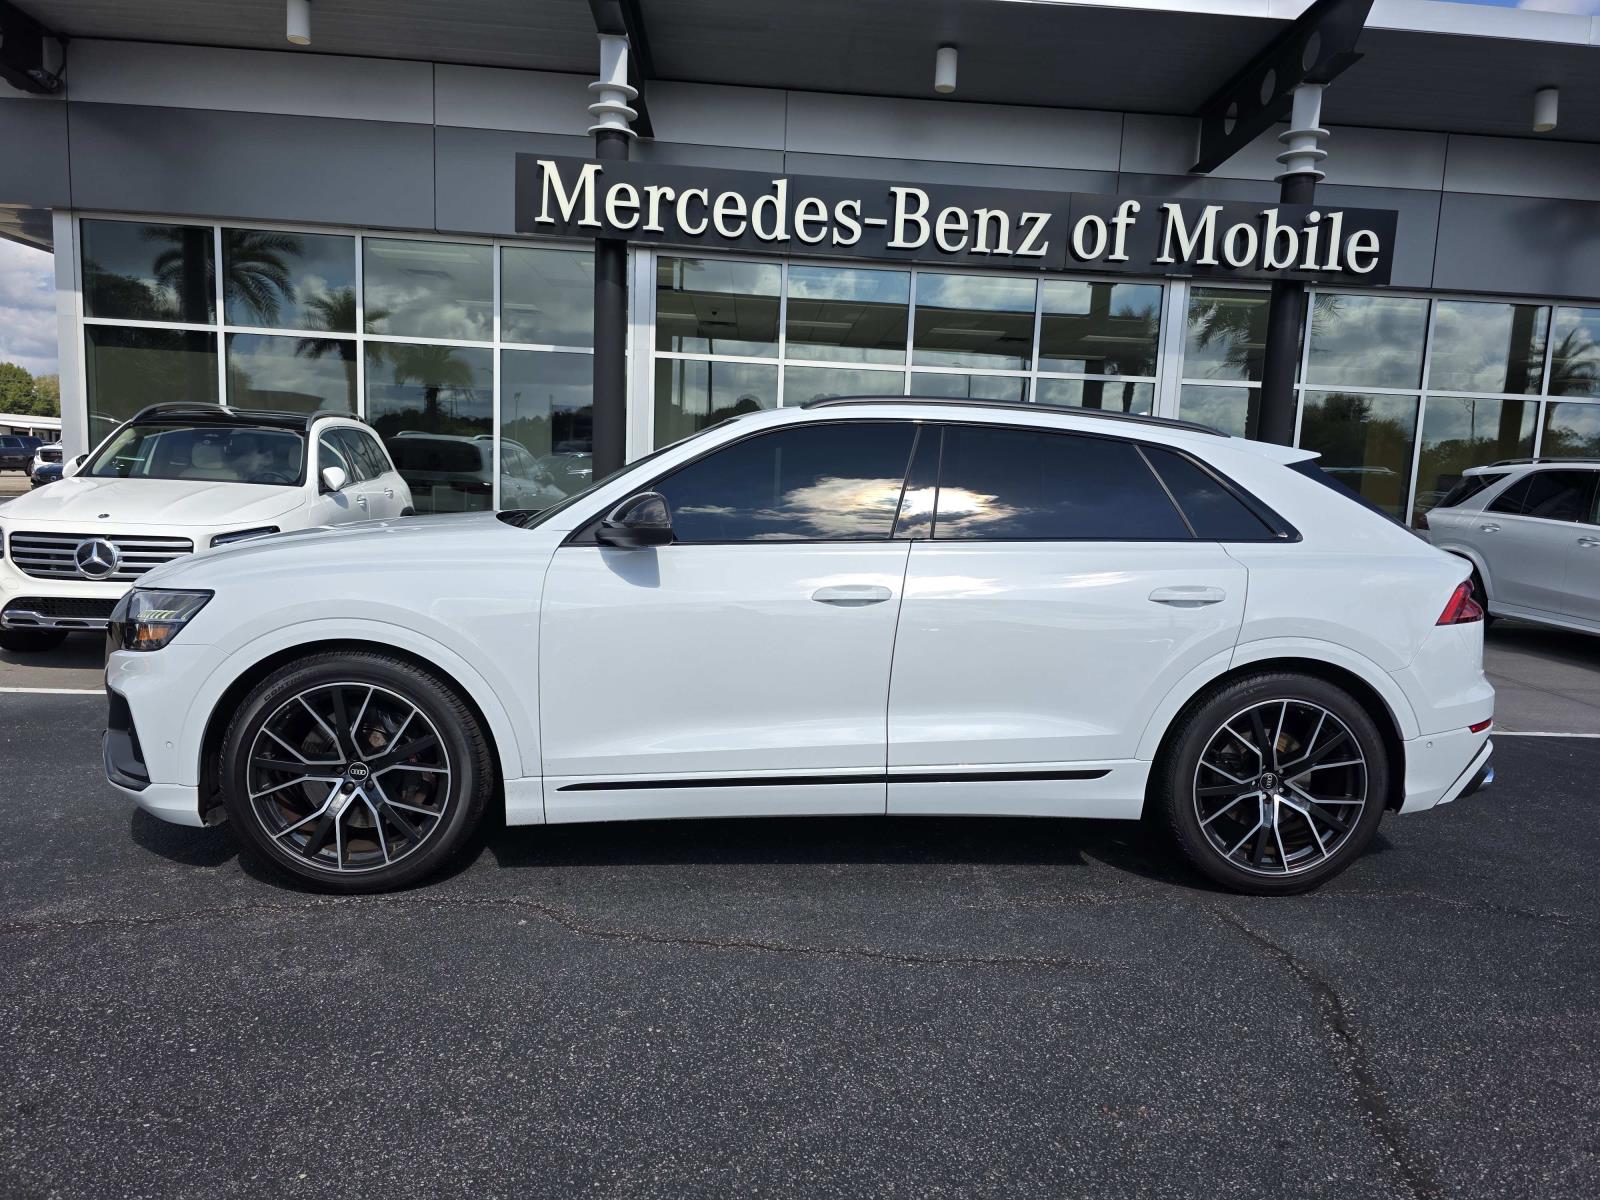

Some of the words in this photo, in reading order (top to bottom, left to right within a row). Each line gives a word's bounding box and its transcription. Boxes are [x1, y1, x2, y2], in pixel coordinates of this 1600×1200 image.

[534, 159, 1053, 256] Mercedes-Benz
[1072, 200, 1141, 261] of
[1156, 202, 1380, 274] Mobile
